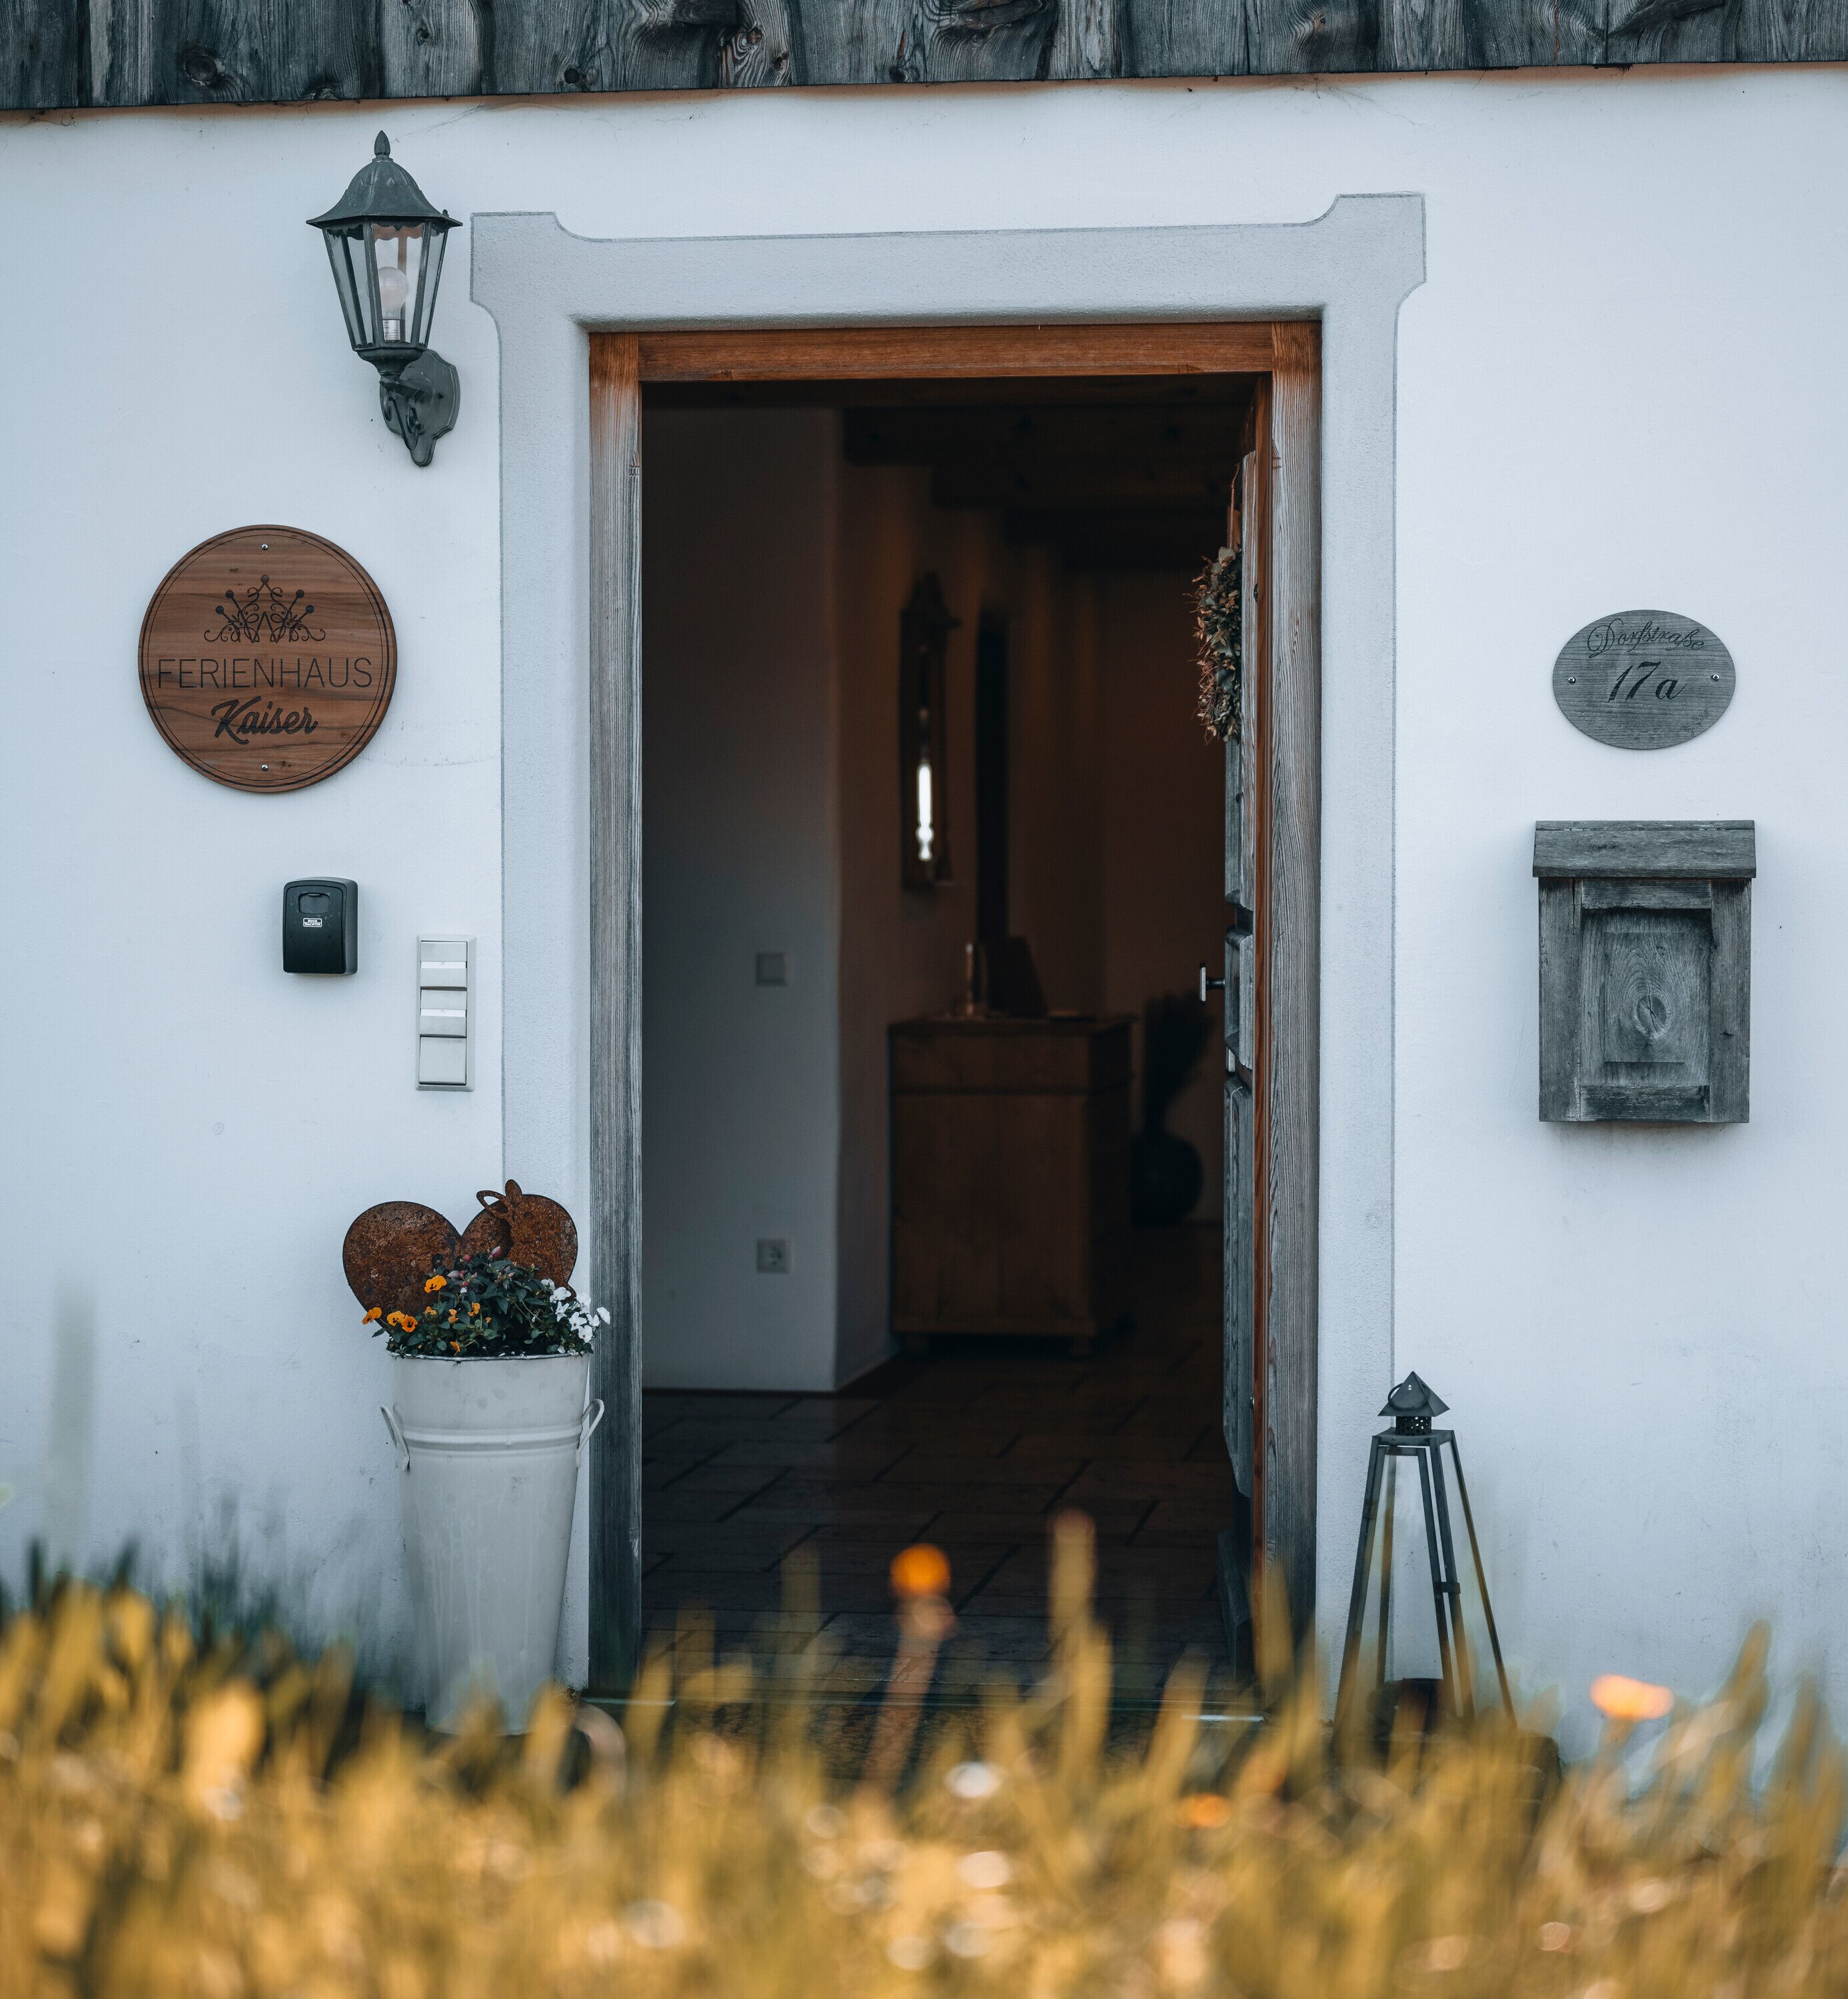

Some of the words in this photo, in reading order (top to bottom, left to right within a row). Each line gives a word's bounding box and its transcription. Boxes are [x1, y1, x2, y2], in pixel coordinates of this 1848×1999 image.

[1587, 618, 1705, 658] Dorfstraße
[158, 657, 373, 689] FERIENHAUS
[1607, 660, 1688, 703] 17a
[211, 695, 319, 746] Kaiser
